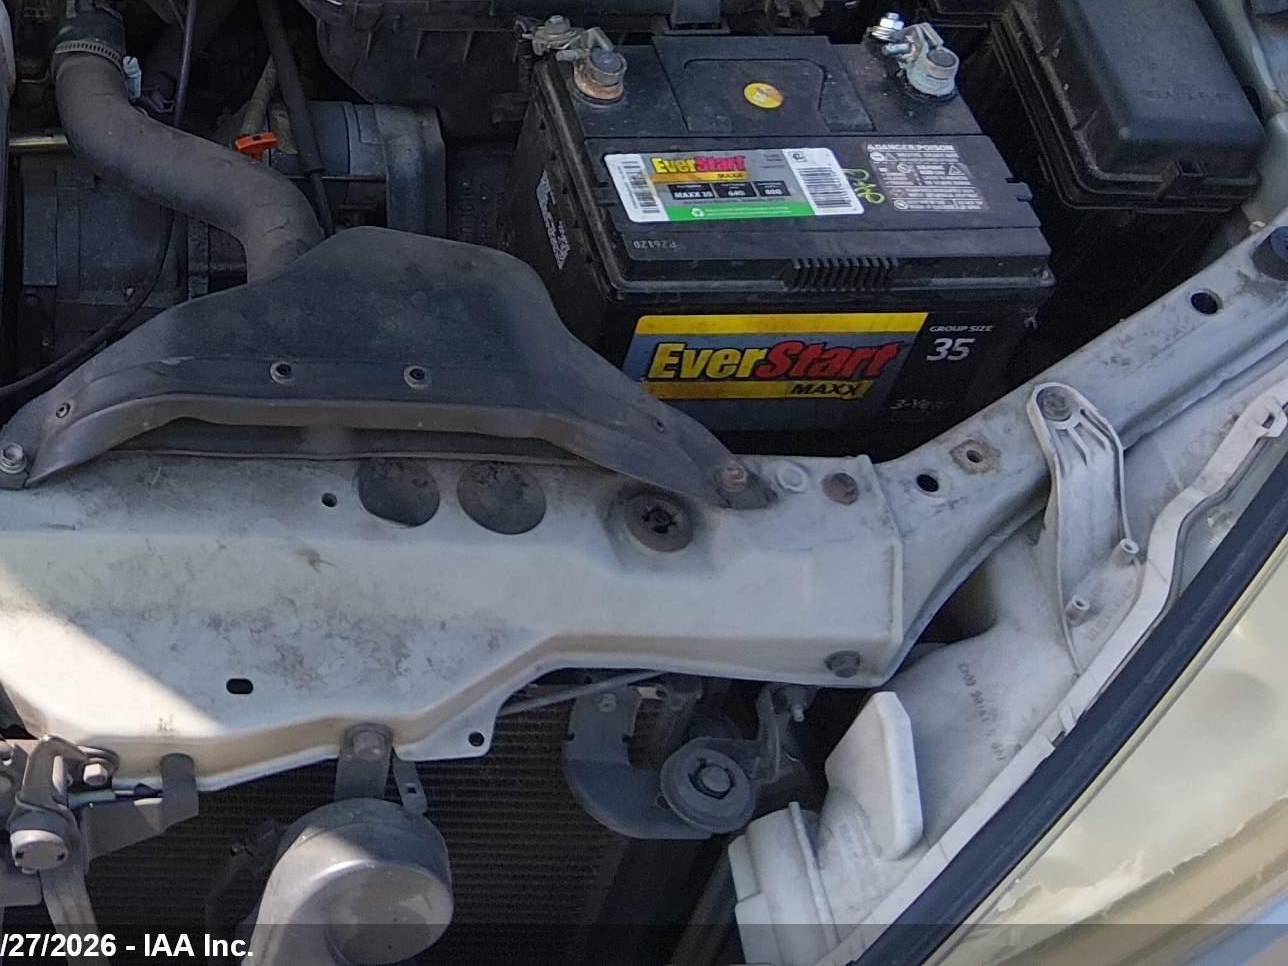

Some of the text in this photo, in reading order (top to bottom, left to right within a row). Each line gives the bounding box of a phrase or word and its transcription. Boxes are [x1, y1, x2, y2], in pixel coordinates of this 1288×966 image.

[650, 155, 746, 174] EverStart
[969, 324, 995, 332] SIZE
[926, 338, 976, 362] 35
[647, 340, 906, 382] EverStart
[790, 381, 863, 397] MAXX
